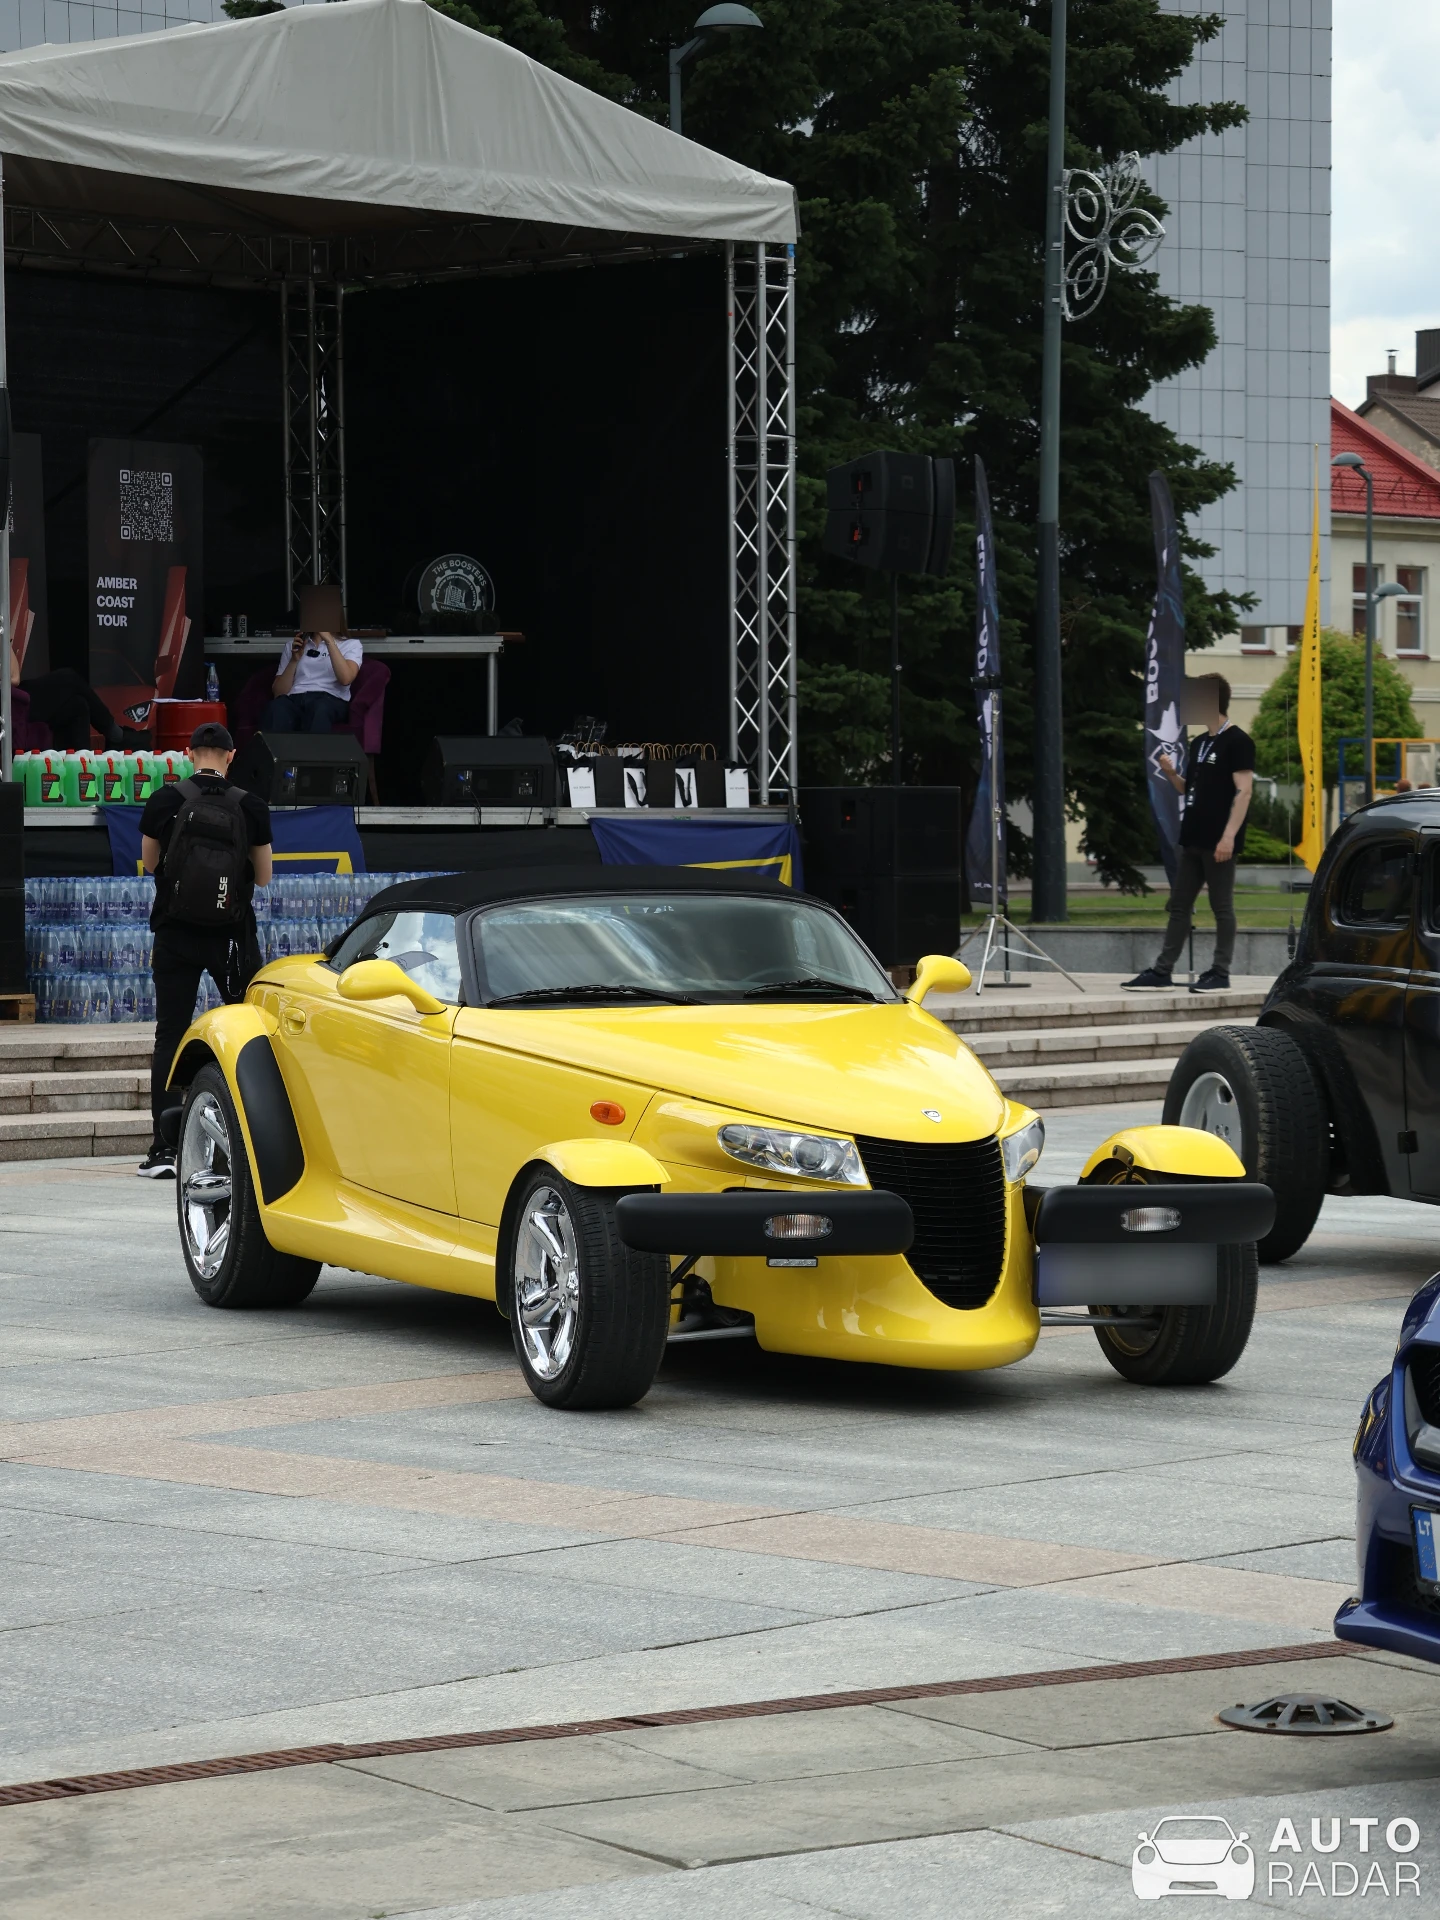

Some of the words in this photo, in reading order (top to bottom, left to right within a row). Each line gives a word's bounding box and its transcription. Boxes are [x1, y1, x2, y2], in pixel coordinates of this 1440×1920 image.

[432, 562, 448, 575] THE
[449, 559, 487, 587] BOOSTERS
[97, 576, 138, 590] AMBER
[97, 596, 135, 609] COAST
[97, 614, 128, 627] TOUR
[216, 876, 228, 909] PULSE
[1417, 1518, 1431, 1537] LT
